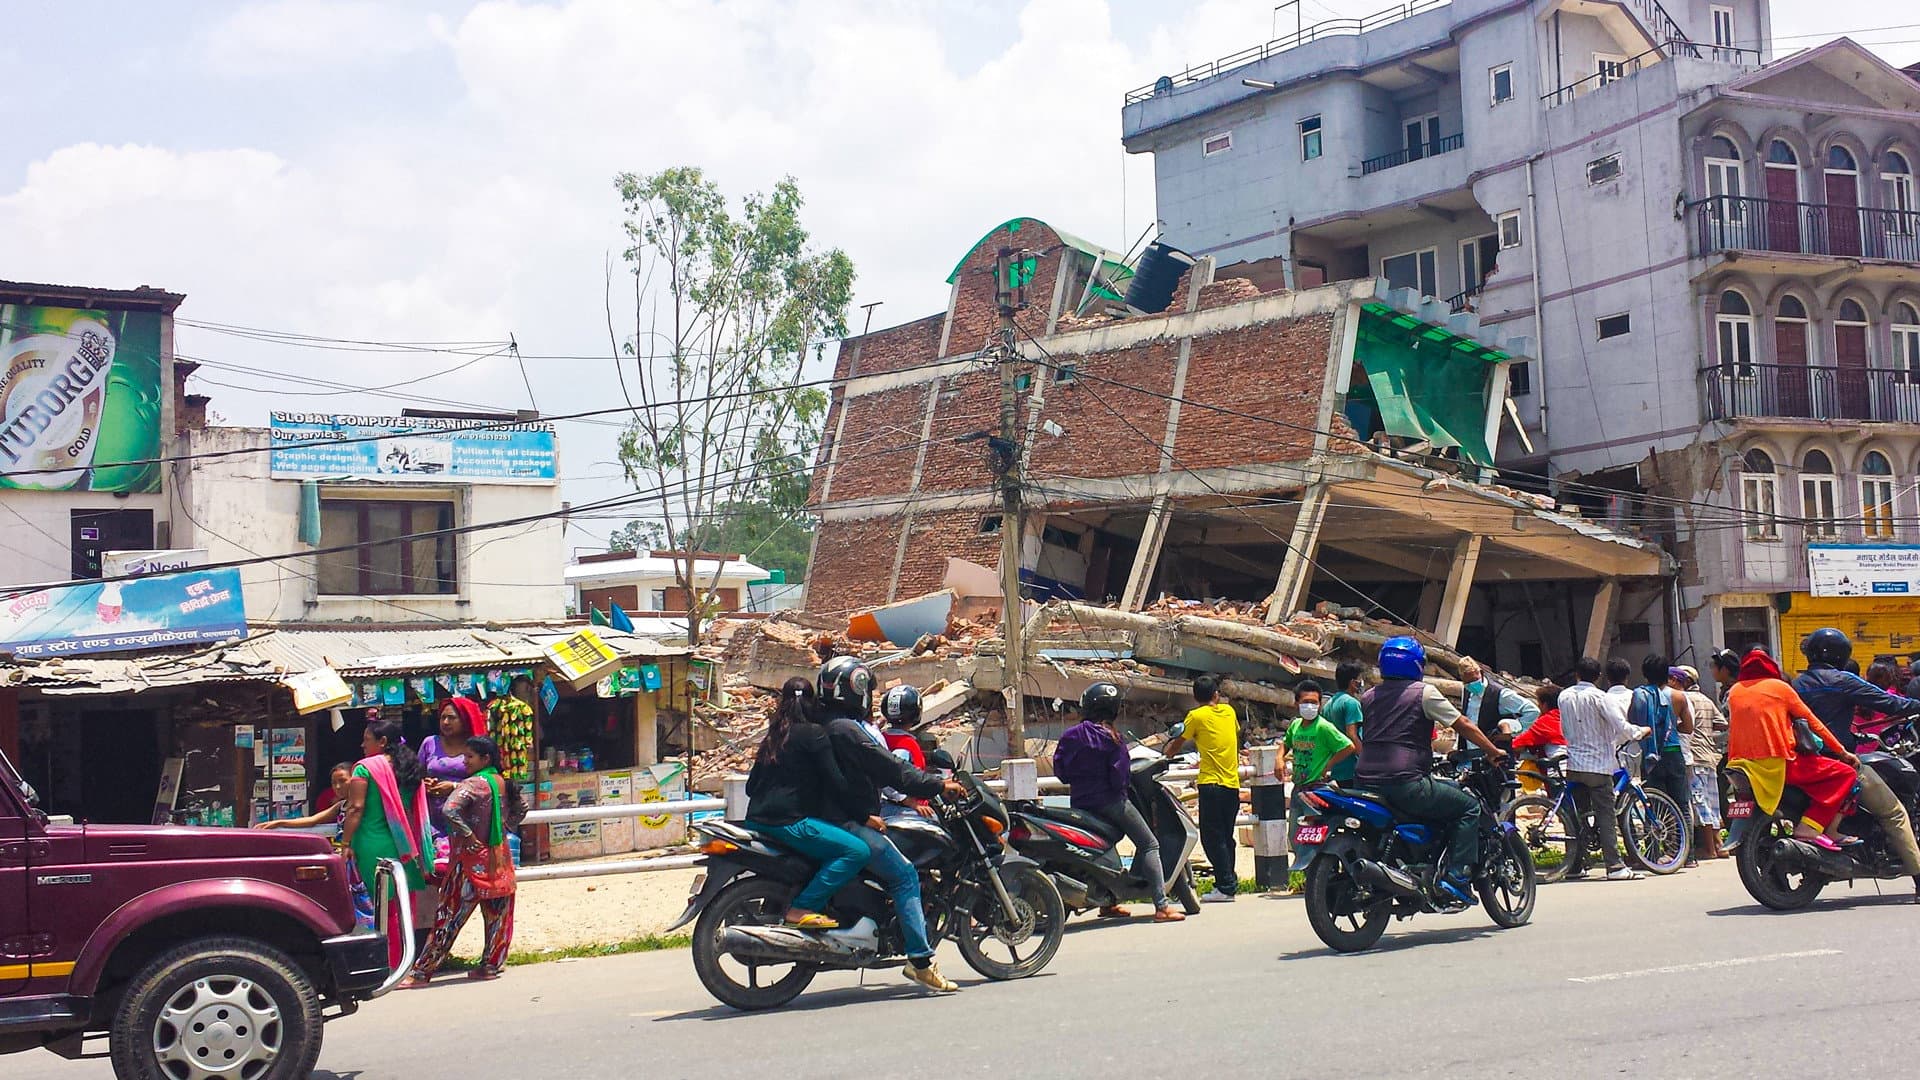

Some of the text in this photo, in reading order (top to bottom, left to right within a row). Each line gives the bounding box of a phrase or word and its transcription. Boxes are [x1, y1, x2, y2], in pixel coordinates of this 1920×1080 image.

[6, 359, 46, 380] QUALITY
[0, 356, 95, 465] TUBORG
[275, 411, 333, 425] GLOBAL
[67, 427, 92, 457] GOLD
[272, 428, 295, 440] Our
[507, 447, 518, 456] all
